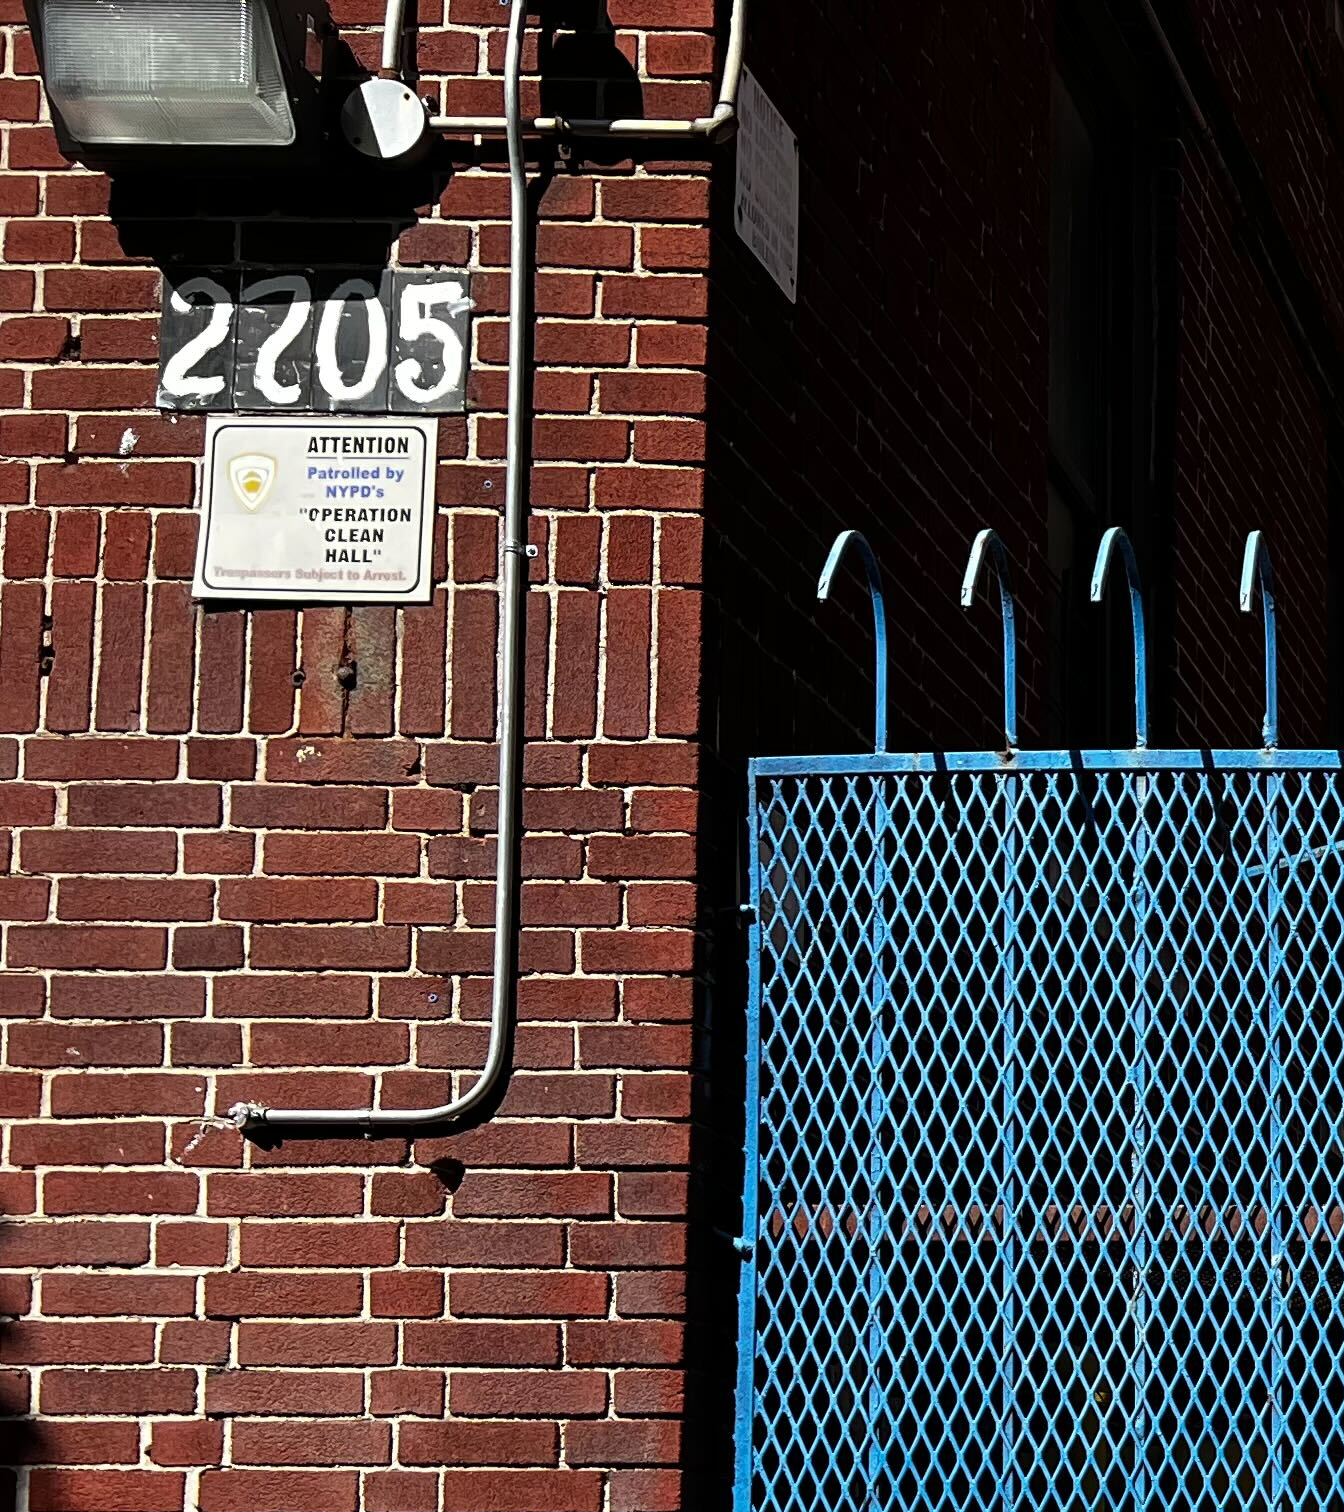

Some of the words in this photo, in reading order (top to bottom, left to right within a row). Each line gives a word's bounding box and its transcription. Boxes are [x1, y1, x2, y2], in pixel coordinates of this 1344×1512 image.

[162, 275, 464, 405] 2705
[307, 436, 409, 455] ATTENTION
[307, 466, 382, 481] Patrolled
[385, 466, 405, 482] by
[325, 485, 385, 499] NYPD's
[324, 527, 385, 543] CLEAN
[324, 548, 383, 564] HALL"
[346, 568, 361, 581] to
